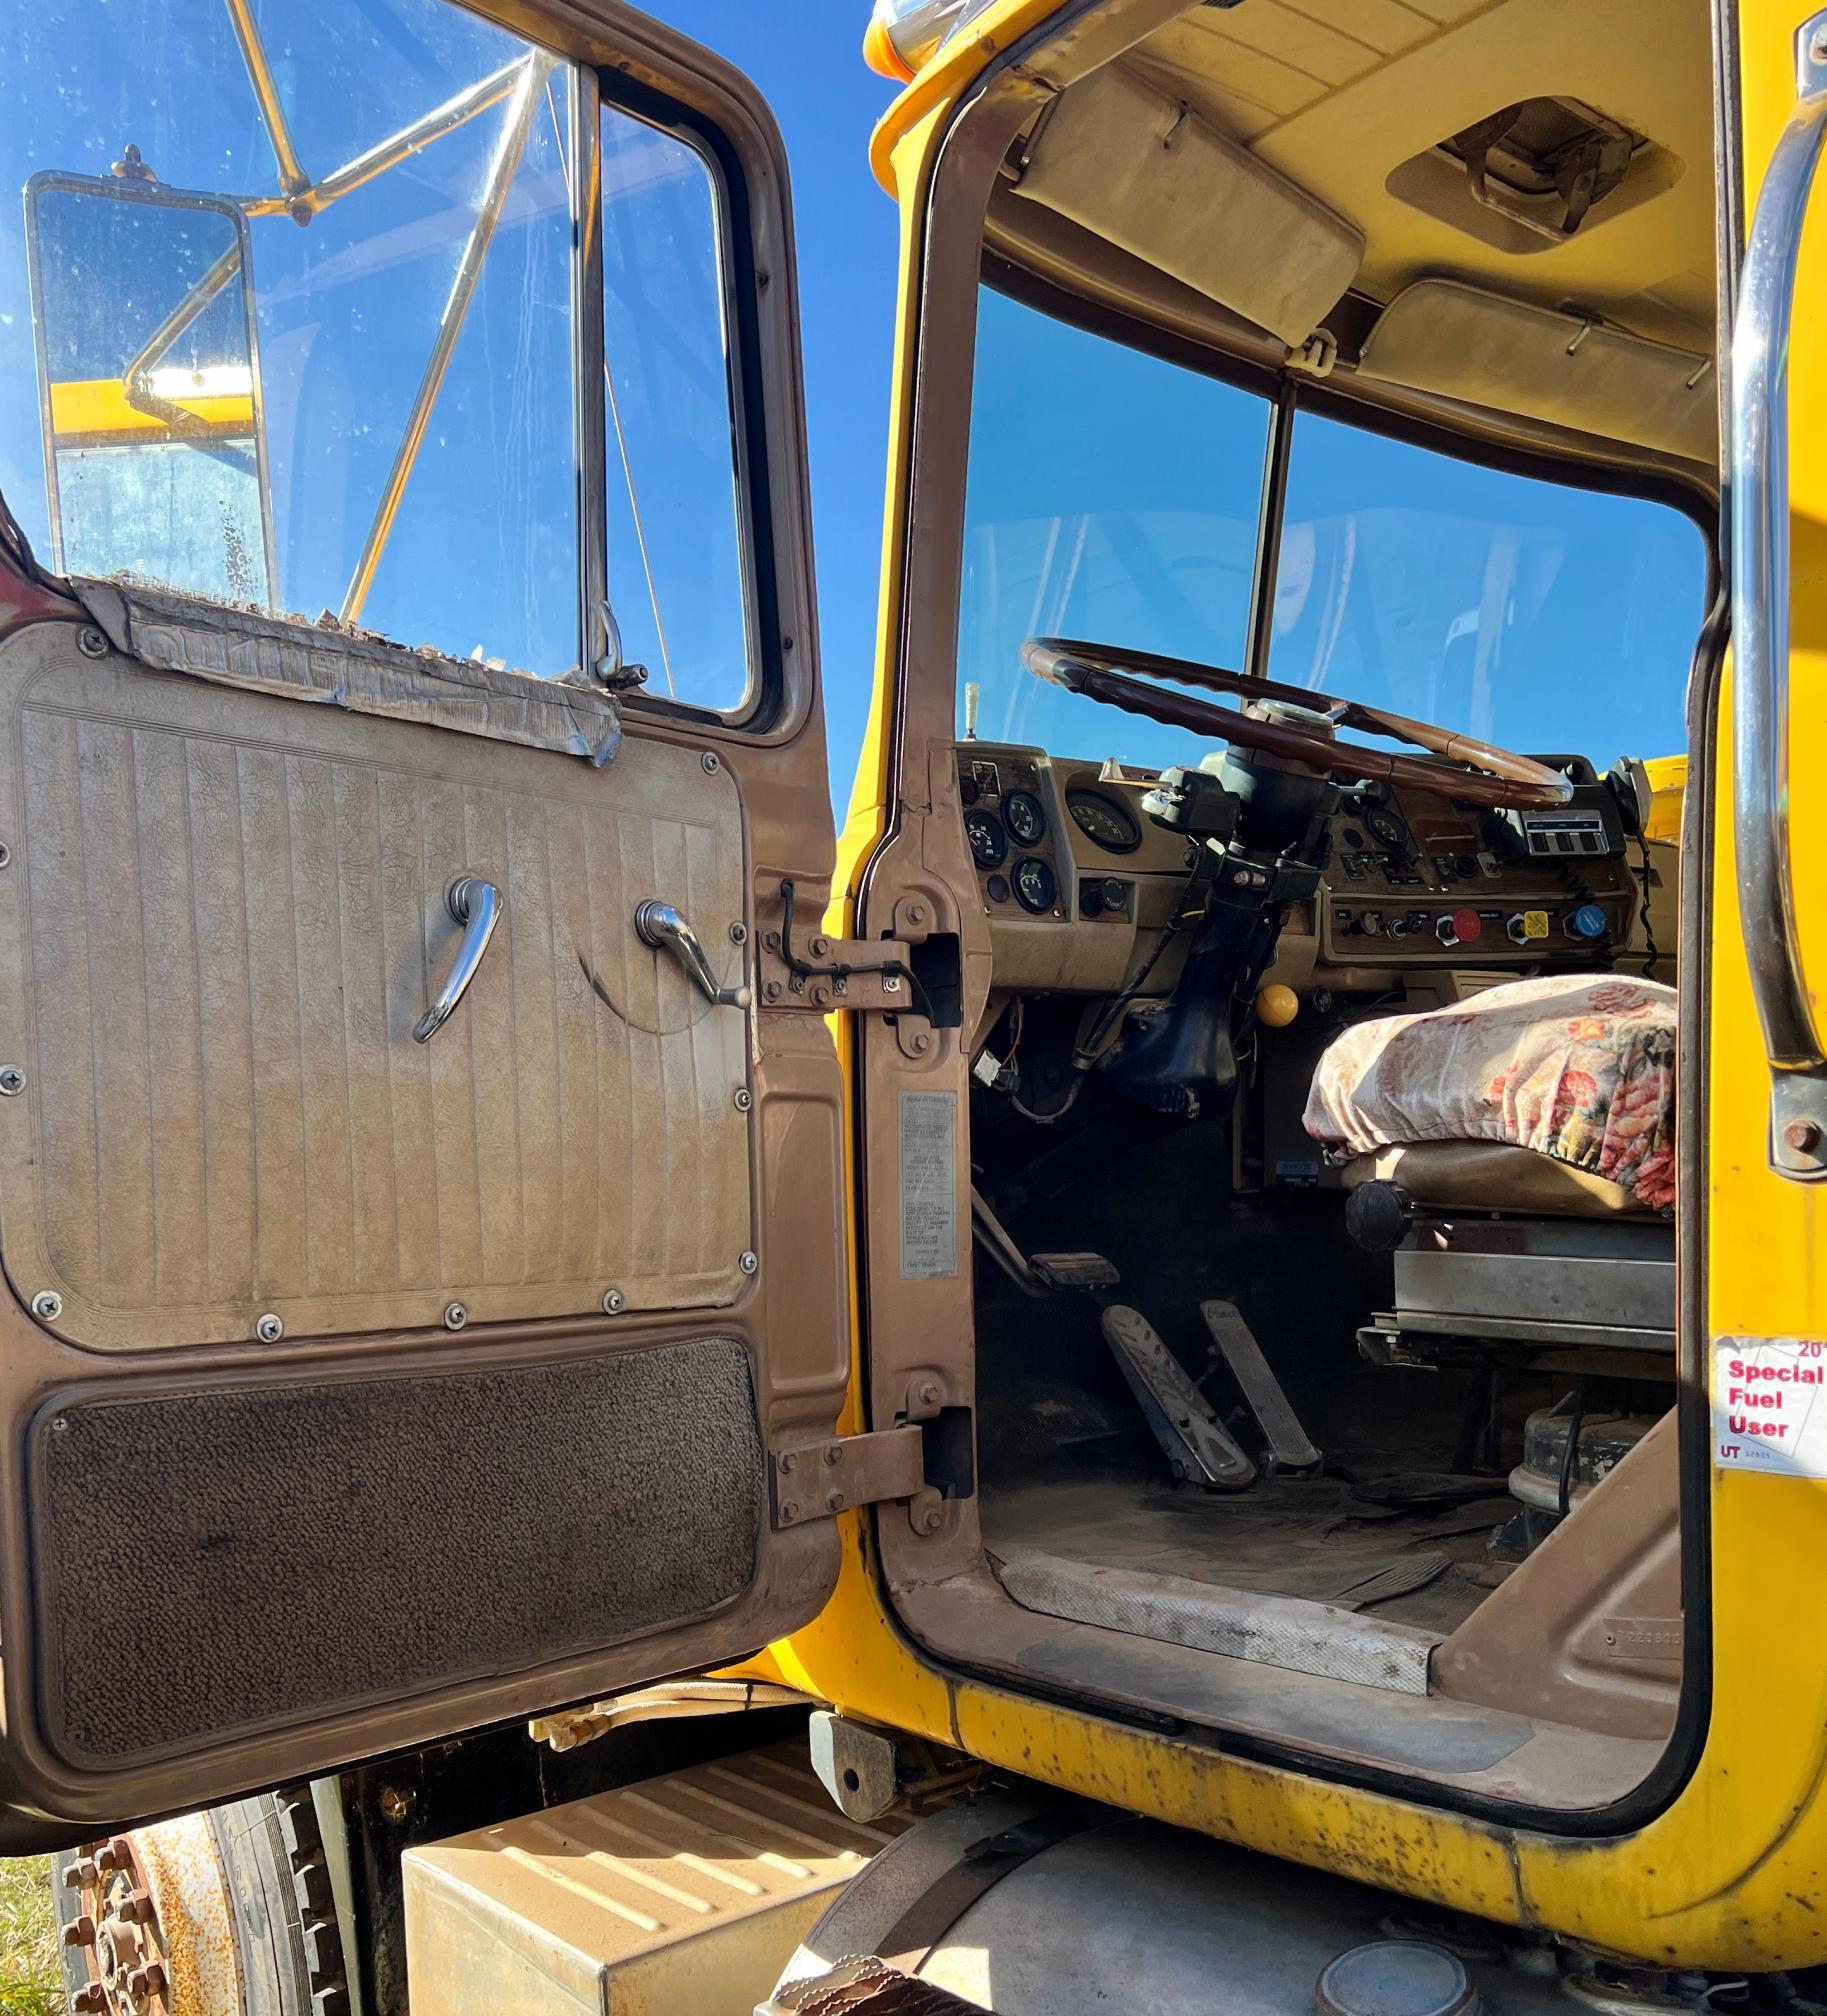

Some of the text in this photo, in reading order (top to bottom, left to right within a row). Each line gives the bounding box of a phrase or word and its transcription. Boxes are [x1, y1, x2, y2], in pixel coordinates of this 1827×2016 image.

[1728, 1359, 1824, 1385] Special
[1728, 1387, 1783, 1409] Fuel
[1728, 1415, 1789, 1438] User
[1720, 1445, 1741, 1459] UT
